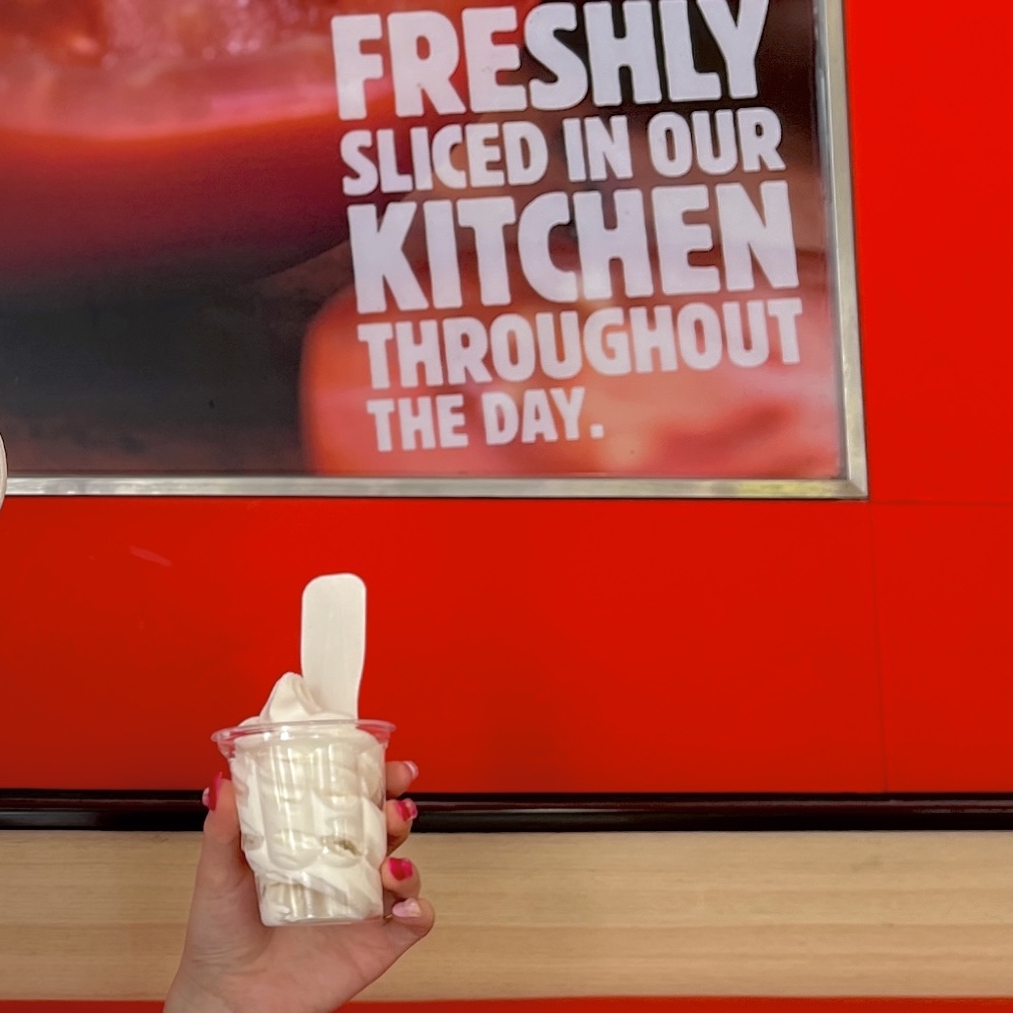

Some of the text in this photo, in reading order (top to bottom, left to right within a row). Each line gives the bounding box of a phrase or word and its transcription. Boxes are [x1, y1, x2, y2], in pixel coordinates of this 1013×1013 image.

[331, 0, 769, 120] FRESHLY
[340, 107, 786, 196] SLICED IN OUR
[347, 180, 799, 315] KITCHEN
[357, 298, 802, 389] THROUGHOUT
[367, 387, 604, 452] THE DAY.
